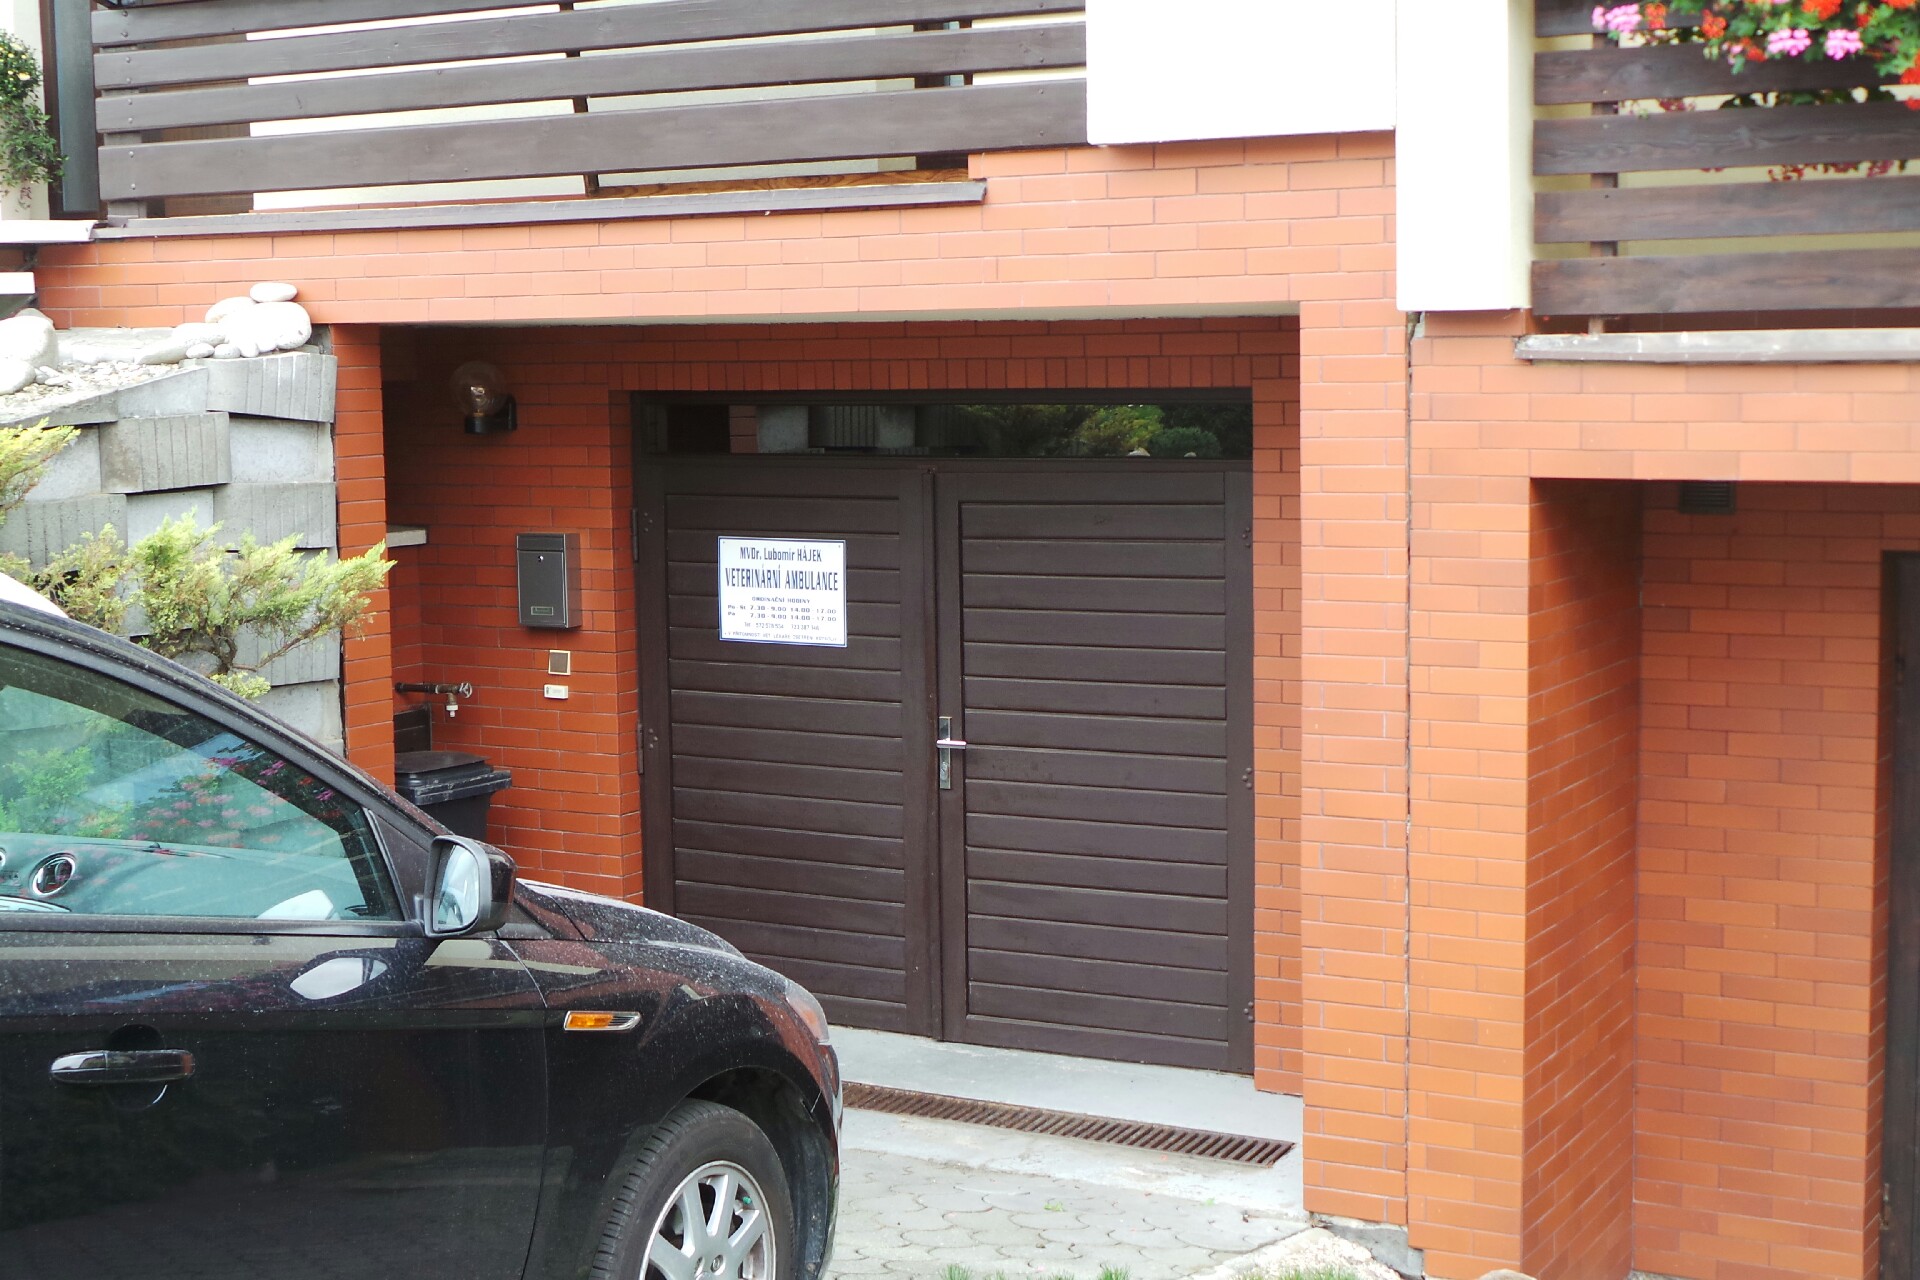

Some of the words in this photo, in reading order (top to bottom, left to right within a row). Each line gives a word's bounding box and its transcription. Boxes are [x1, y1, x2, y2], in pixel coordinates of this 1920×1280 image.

[740, 546, 762, 560] MVDr.
[797, 545, 822, 562] HÁJEK
[725, 564, 781, 589] VETERINÁRNÍ
[785, 569, 839, 591] AMBULANCE
